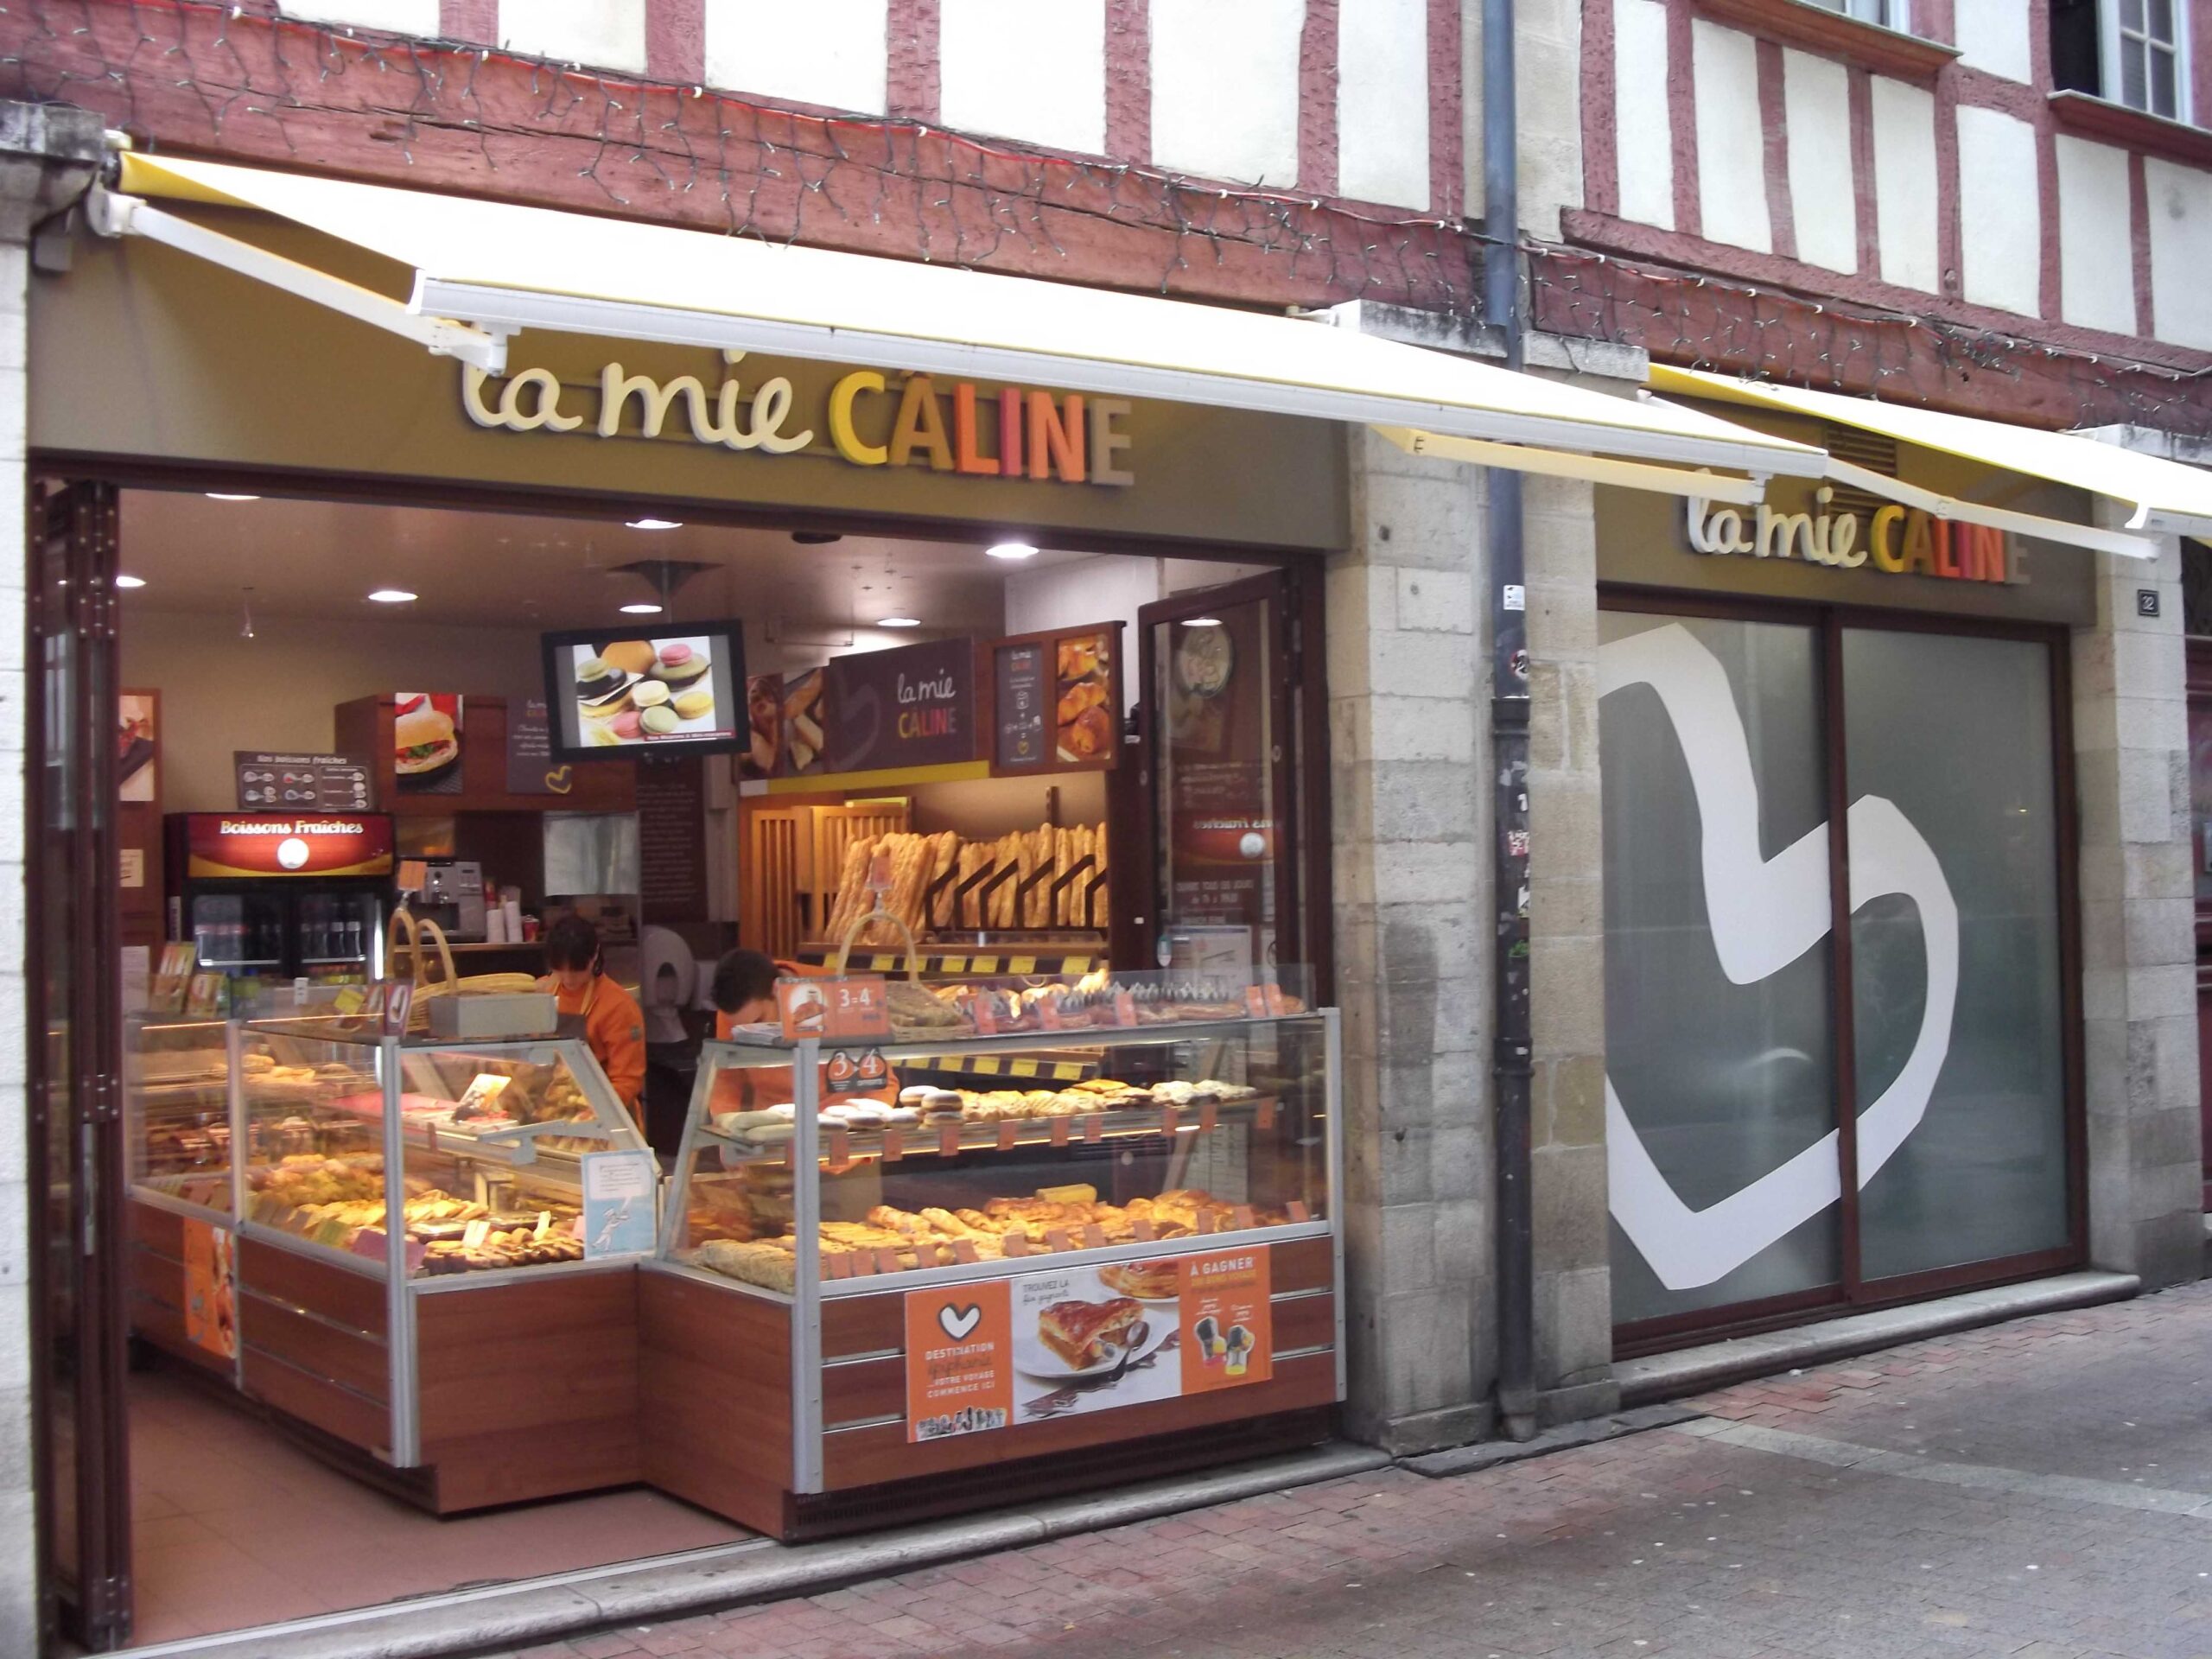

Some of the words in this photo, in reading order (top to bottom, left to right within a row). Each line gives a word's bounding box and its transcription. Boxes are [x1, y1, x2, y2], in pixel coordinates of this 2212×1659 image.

[598, 348, 814, 454] mie
[1688, 467, 1755, 555] la
[1755, 486, 1868, 569] mie
[898, 672, 917, 703] la
[918, 667, 957, 701] mie
[220, 820, 292, 834] Boissons
[1202, 1256, 1254, 1274] GAGNER
[1023, 1281, 1058, 1293] TROUVEZ
[1059, 1279, 1070, 1288] LA
[925, 1342, 995, 1360] DESTINATION
[963, 1370, 995, 1381] VOYAGE
[926, 1382, 979, 1398] COMMENCE
